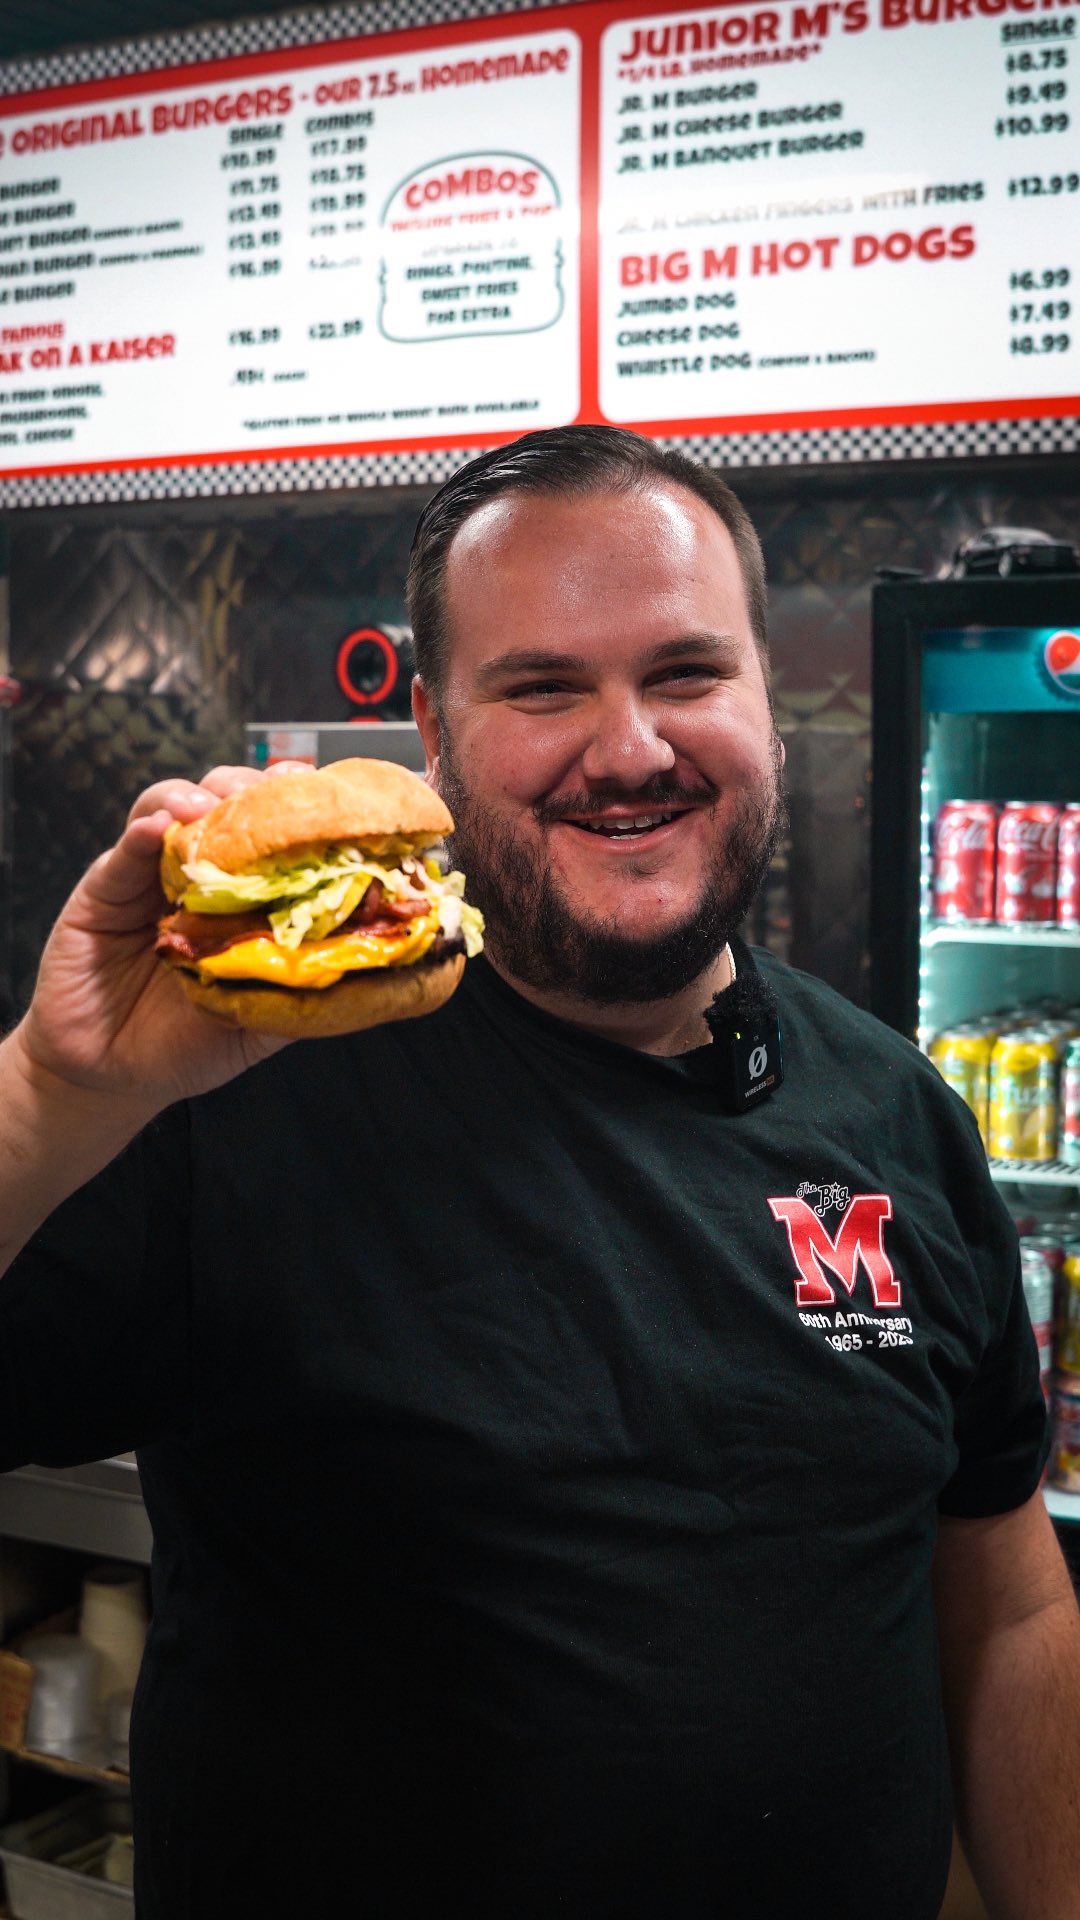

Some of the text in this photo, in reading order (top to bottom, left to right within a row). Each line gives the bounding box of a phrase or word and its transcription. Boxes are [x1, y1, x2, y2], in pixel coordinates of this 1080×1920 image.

[620, 10, 780, 62] JUNIOR
[792, 0, 868, 39] M'S
[1001, 16, 1075, 42] SINGLE
[1006, 48, 1067, 73] $8.75
[11, 108, 143, 156] ORIGINAL
[152, 83, 294, 135] BURGERS
[315, 77, 362, 106] OUR
[368, 71, 399, 98] 7.5
[421, 47, 570, 91] HOMEMADE
[617, 80, 1067, 115] JR. M BURGER $9.49
[229, 123, 284, 146] SINGLE
[617, 102, 1069, 144] JR. M CHEESE BURGER $10.99
[617, 131, 864, 174] JR. M BANQUET BURGER
[0, 177, 60, 200] BURGER
[405, 168, 540, 209] COMBOS
[863, 188, 917, 209] WITH
[923, 181, 985, 206] FRIES
[1008, 173, 1080, 198] $12.99
[14, 201, 76, 225] BURGER
[29, 224, 91, 249] BURGER
[33, 252, 95, 276] BURGER
[619, 224, 976, 288] BIG M HOT DOGS
[14, 281, 76, 303] BURGER
[616, 268, 1070, 318] JUMBO DOG $6.99
[616, 300, 1071, 347] CHEESE DOG $7.49
[30, 345, 62, 369] ON
[68, 342, 83, 367] A
[89, 333, 176, 364] KAISER
[616, 356, 705, 378] WHISTLE
[711, 352, 752, 371] DOG
[1009, 332, 1070, 356] $8.99
[744, 1080, 767, 1099] WIRELESS
[796, 1181, 851, 1218] The Big
[767, 1194, 903, 1308] M
[798, 1312, 833, 1329] 60th
[825, 1333, 863, 1352] 1965
